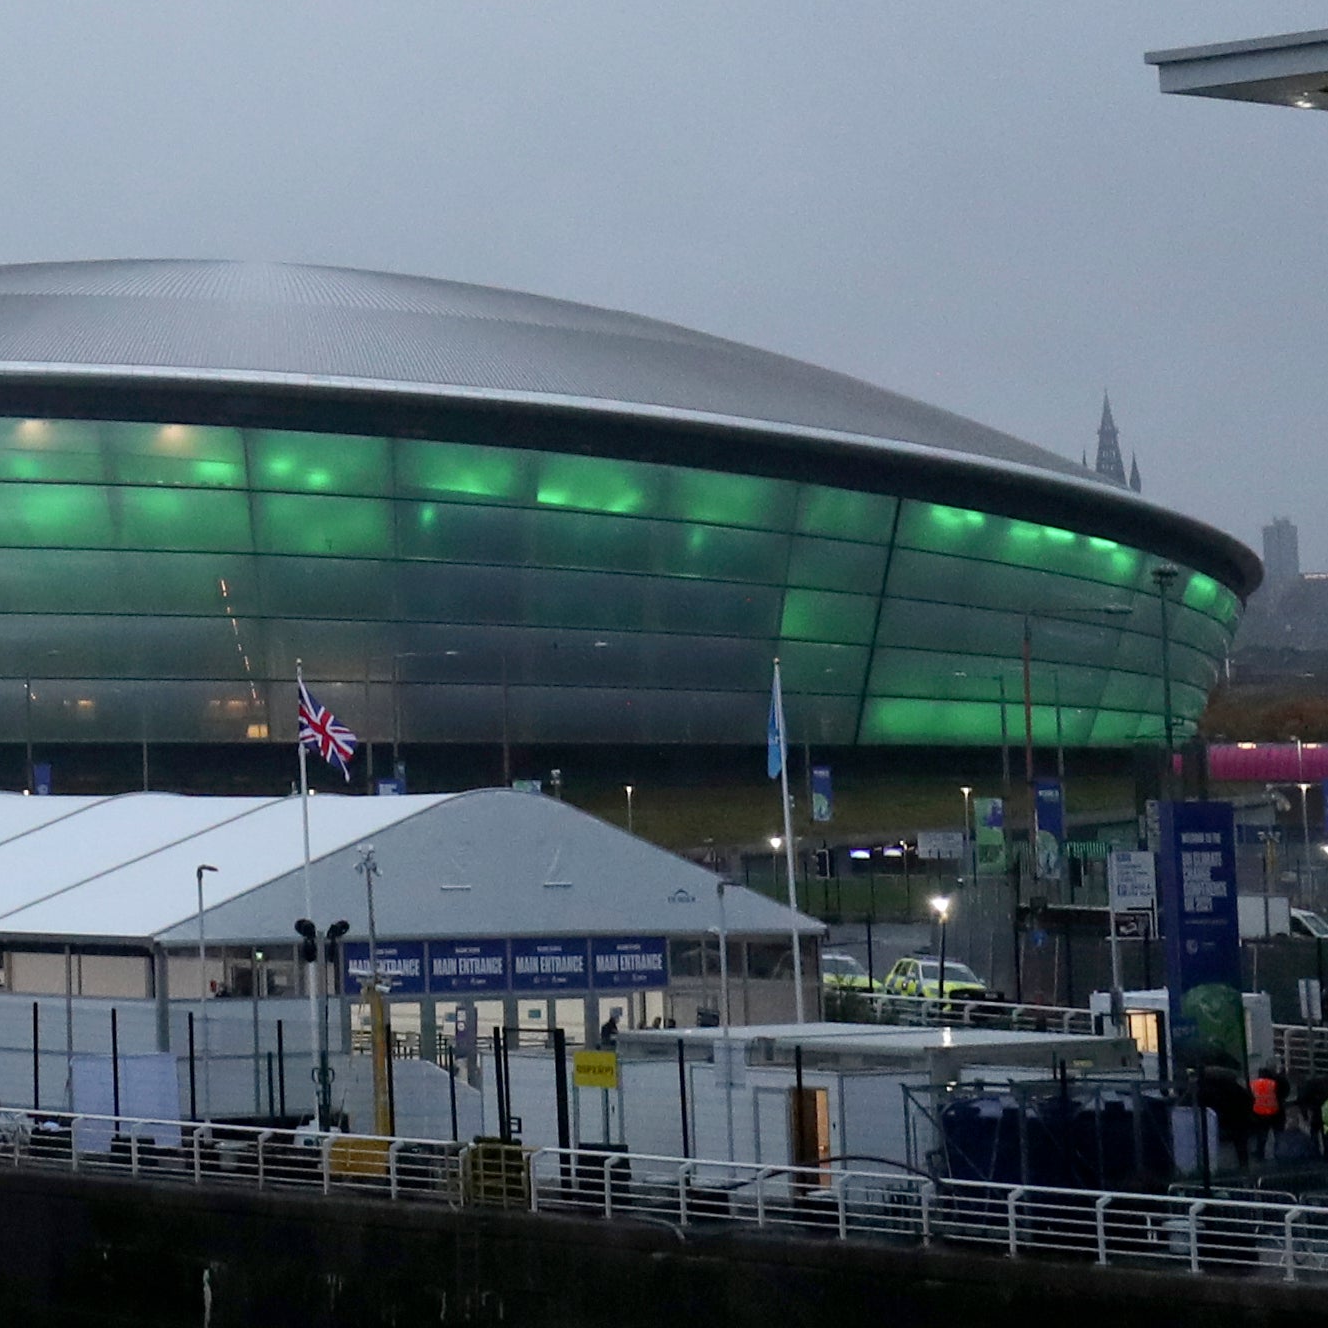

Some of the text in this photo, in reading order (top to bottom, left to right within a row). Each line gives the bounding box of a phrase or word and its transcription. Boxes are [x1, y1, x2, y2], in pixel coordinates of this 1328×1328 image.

[433, 957, 502, 975] MAIN ENTRANCE
[515, 956, 584, 974] MAIN ENTRANCE
[596, 954, 663, 972] MAIN ENTRANCE
